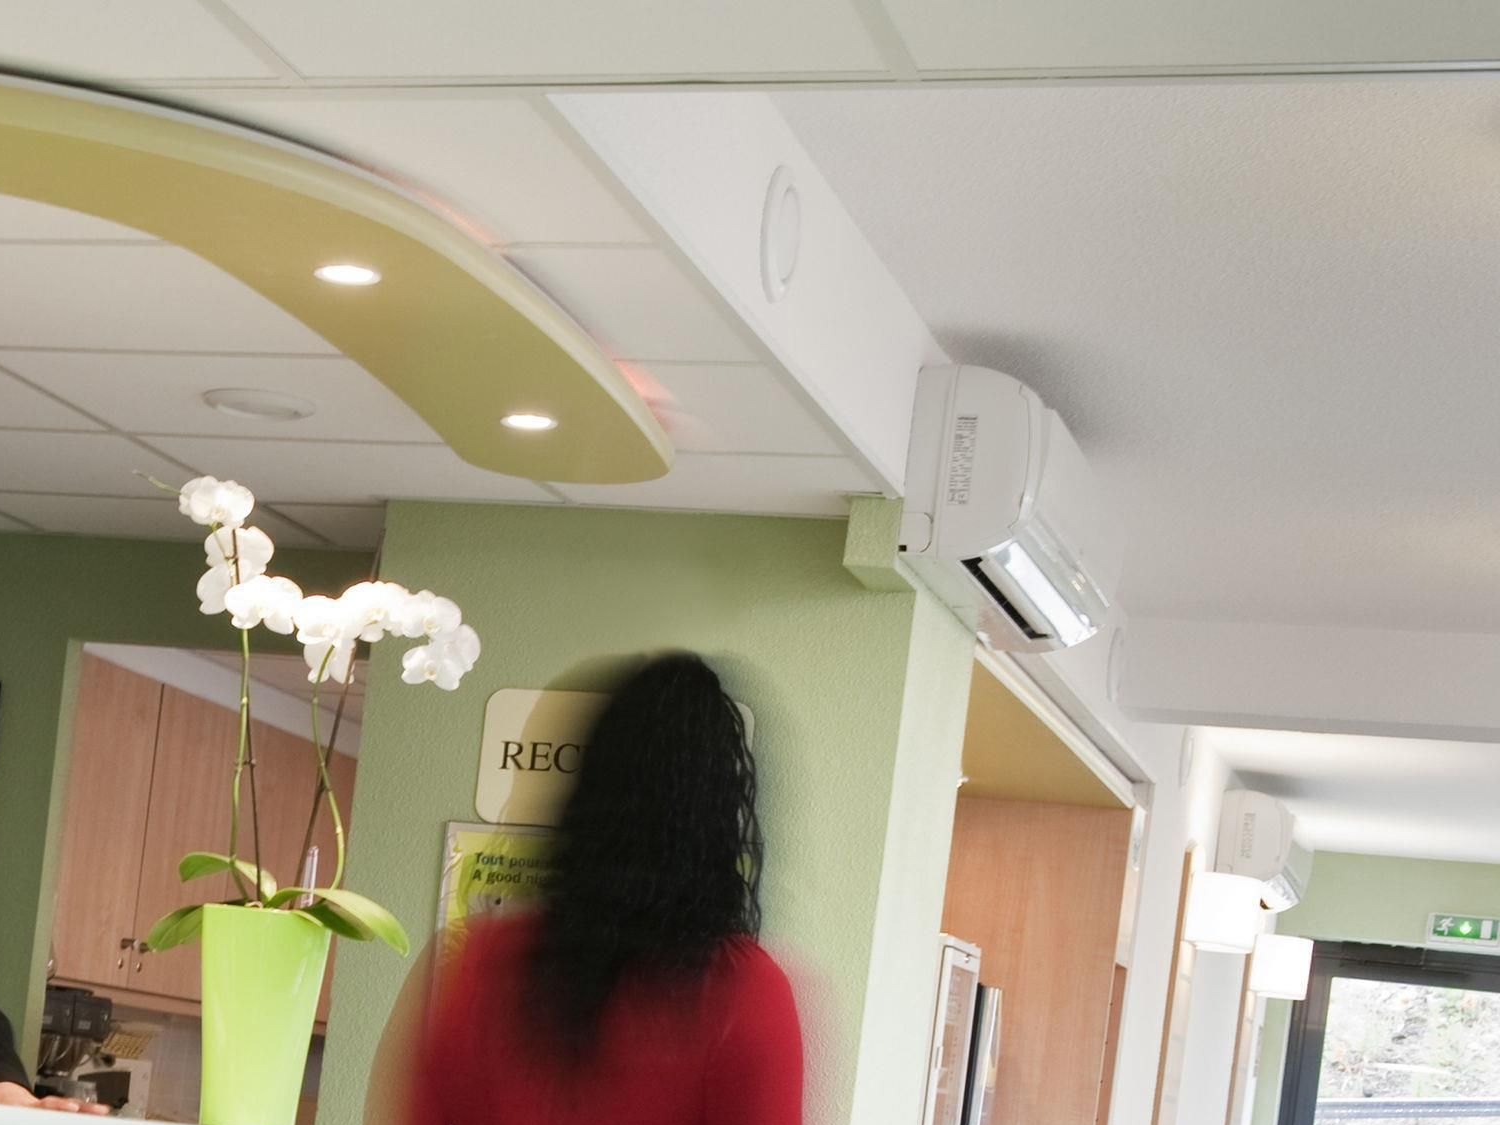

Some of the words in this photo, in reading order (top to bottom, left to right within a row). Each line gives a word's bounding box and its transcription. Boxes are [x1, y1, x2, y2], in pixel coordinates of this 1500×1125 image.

[474, 851, 505, 866] Tout
[472, 869, 482, 881] A
[485, 870, 522, 885] good
